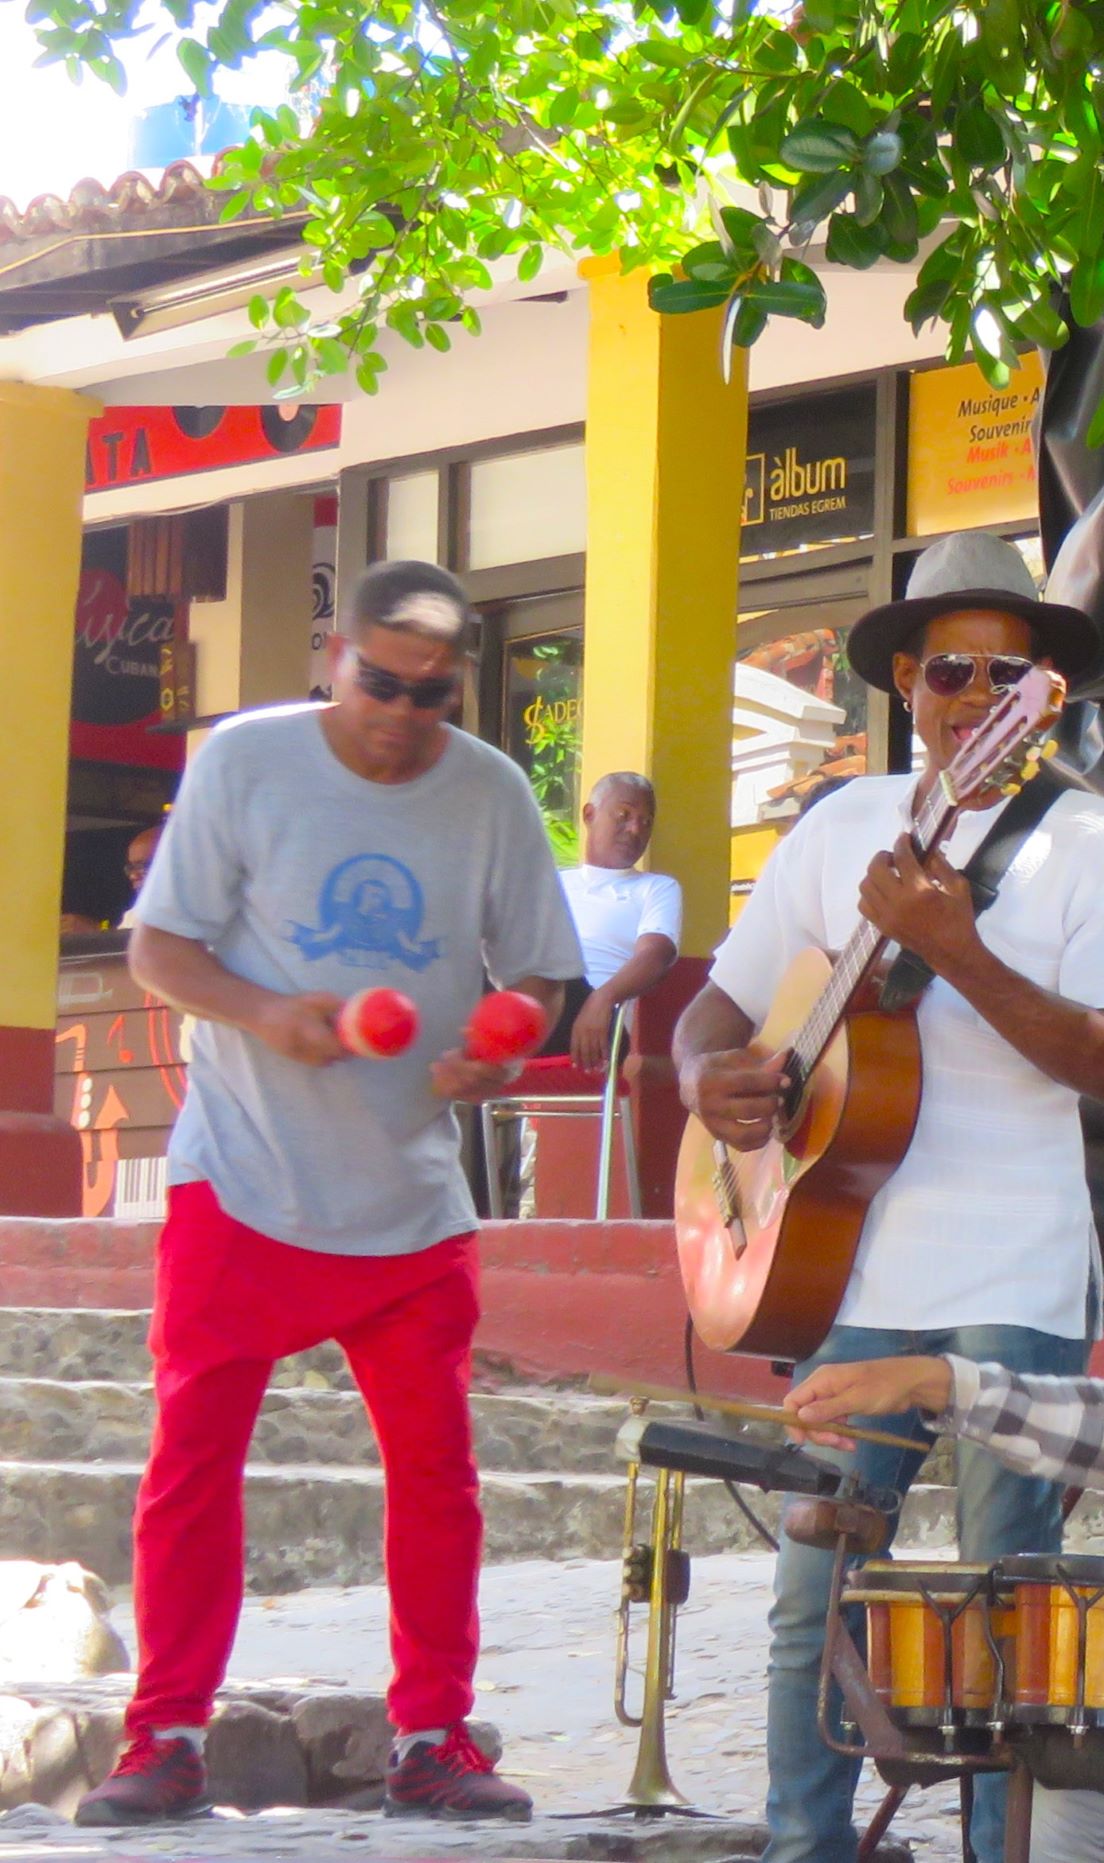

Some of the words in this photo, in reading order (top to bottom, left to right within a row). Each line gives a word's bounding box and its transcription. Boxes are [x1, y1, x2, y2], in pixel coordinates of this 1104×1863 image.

[957, 394, 1019, 418] Musique
[966, 441, 1009, 464] Musik
[770, 447, 846, 501] àlbum
[769, 502, 811, 521] TIENDAS
[811, 495, 846, 514] EGREM
